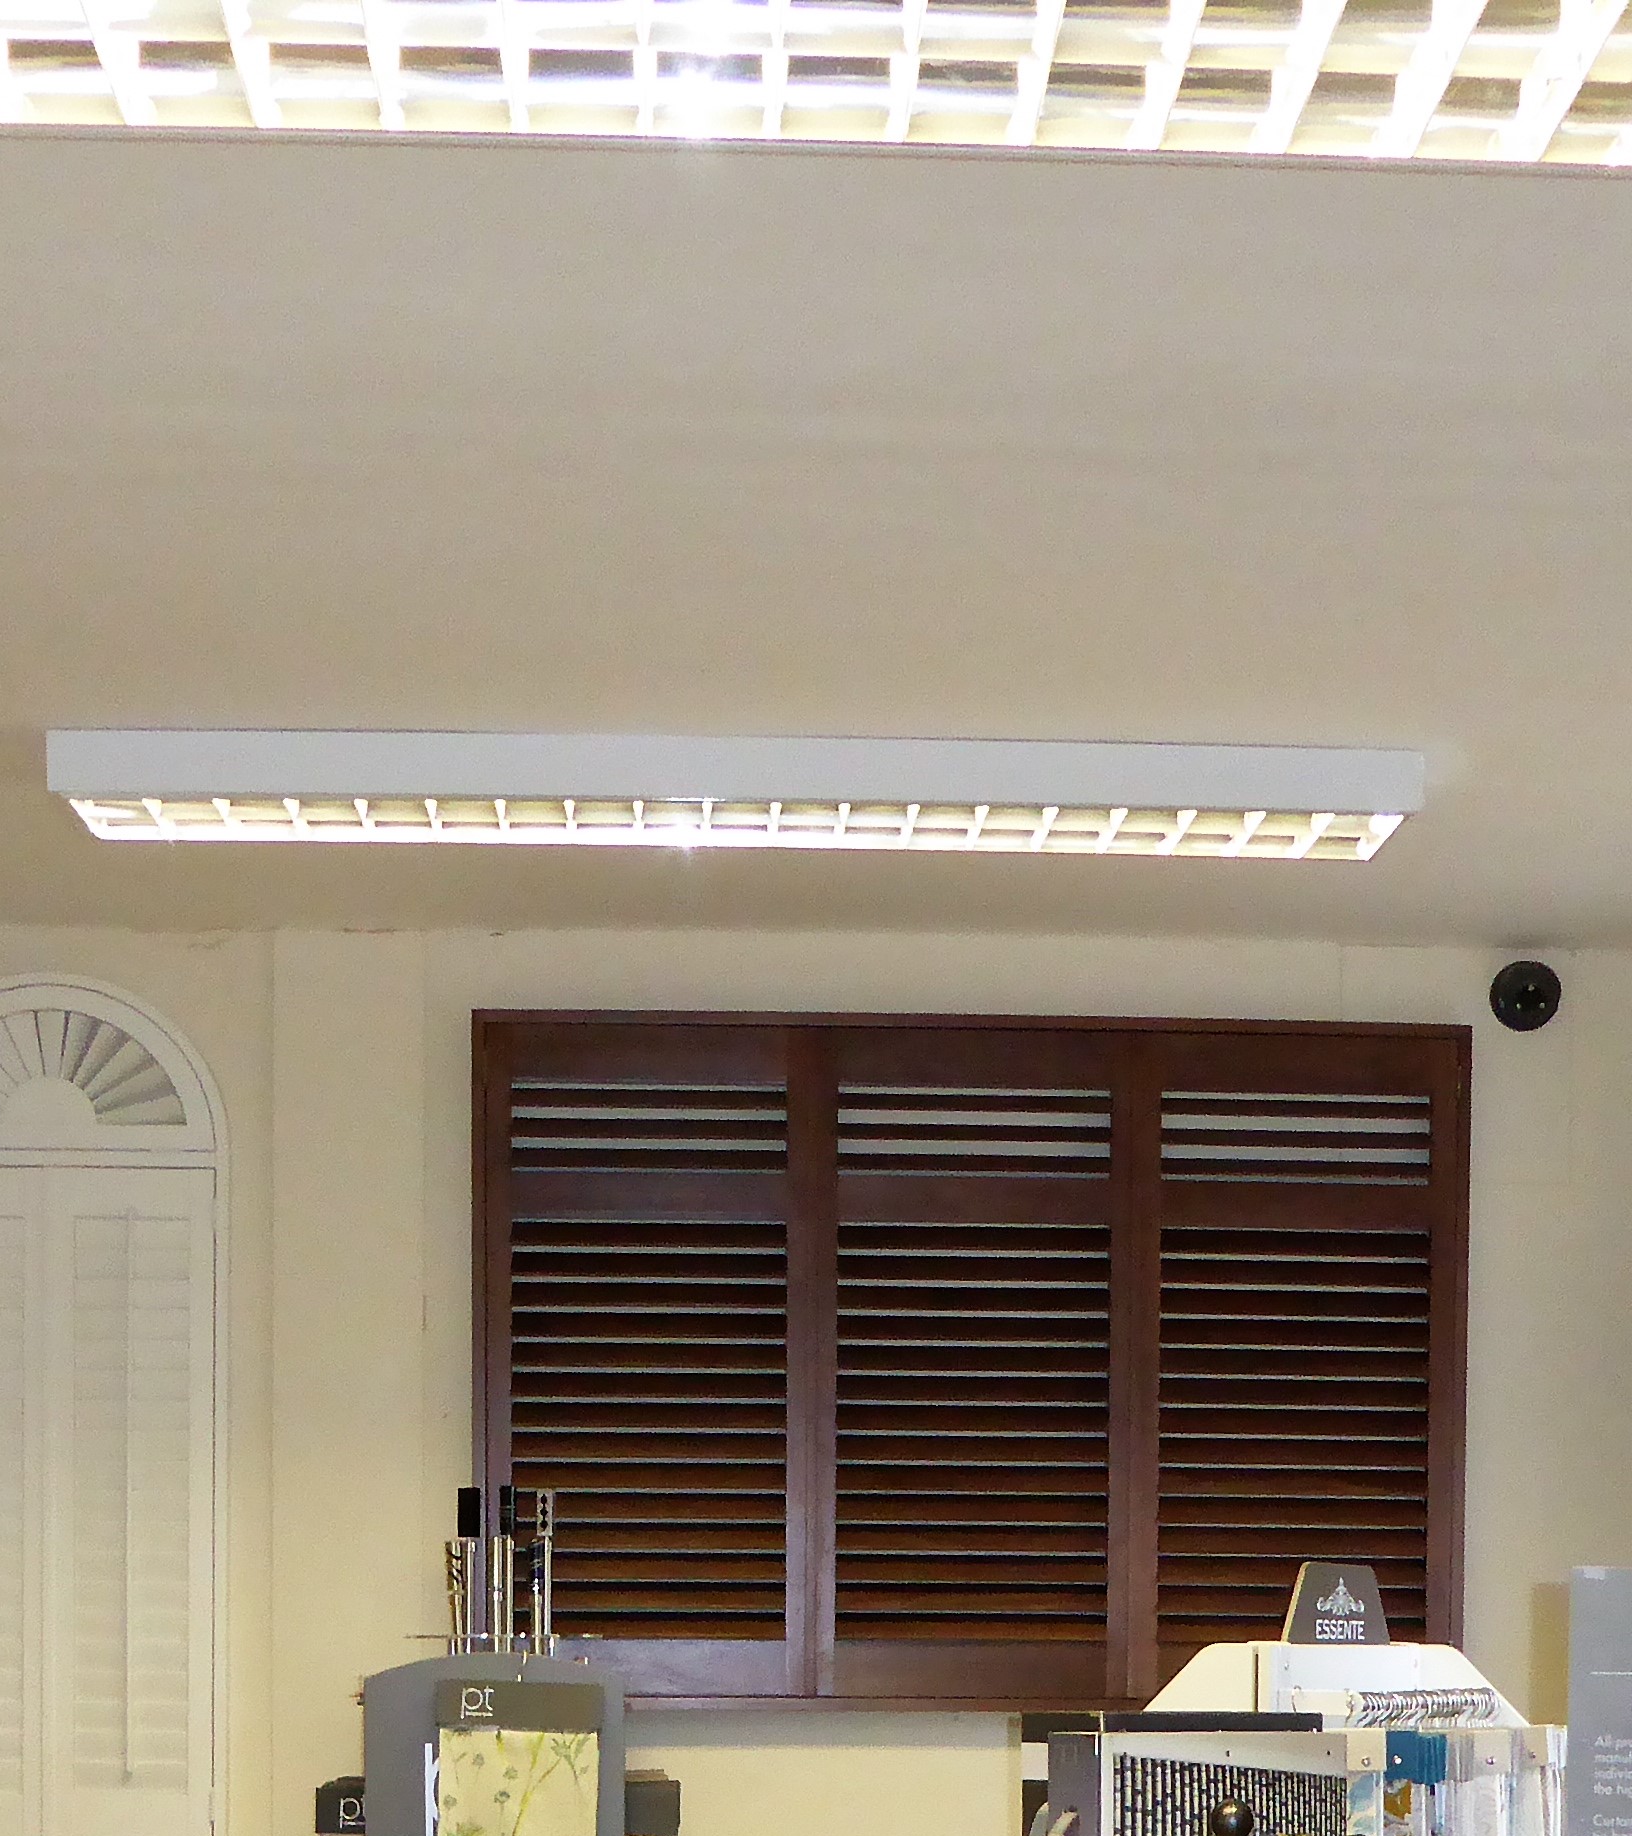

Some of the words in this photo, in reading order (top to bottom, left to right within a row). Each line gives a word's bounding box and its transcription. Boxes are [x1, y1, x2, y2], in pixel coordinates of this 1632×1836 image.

[1316, 1619, 1365, 1640] ESSENTE
[461, 1686, 494, 1719] pt
[1594, 1782, 1612, 1794] the
[340, 1797, 365, 1828] p
